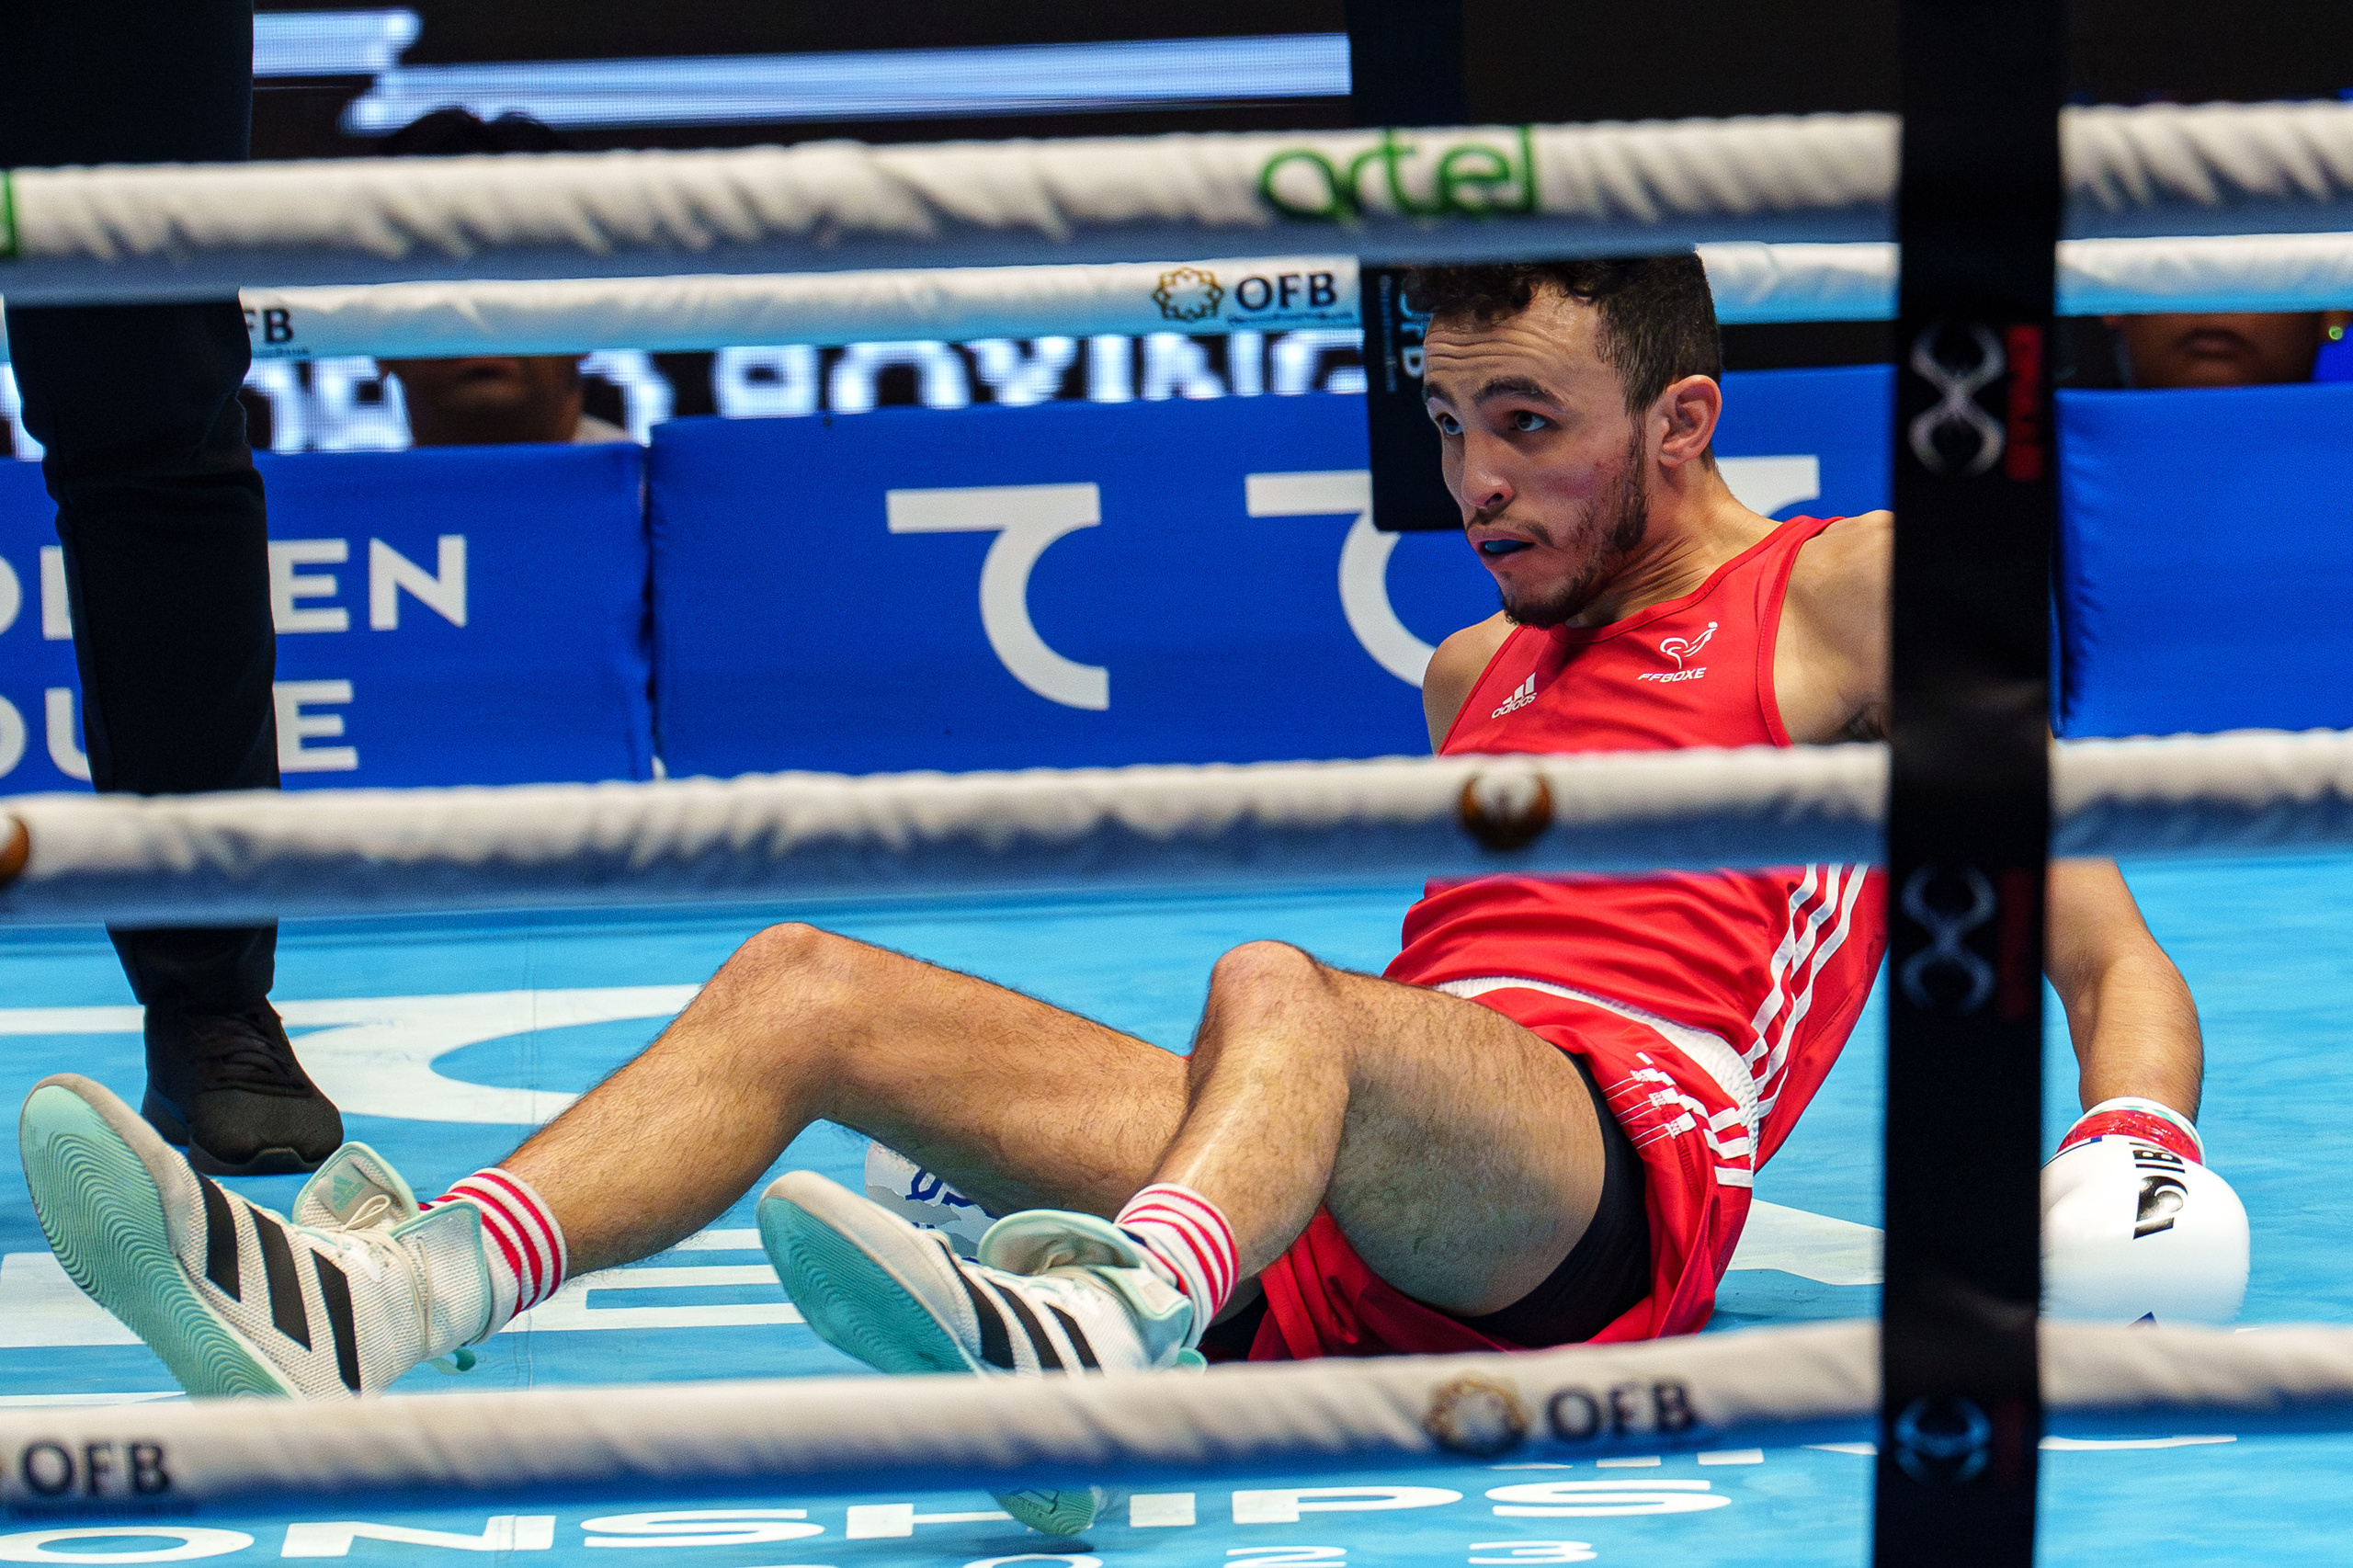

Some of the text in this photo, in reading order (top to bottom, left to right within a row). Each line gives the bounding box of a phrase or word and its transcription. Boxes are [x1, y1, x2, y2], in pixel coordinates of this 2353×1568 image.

[1257, 125, 1537, 221] artel
[1235, 270, 1337, 312] OFB
[1637, 667, 1707, 682] FFBOXE
[1491, 692, 1538, 719] adidas
[1546, 1381, 1694, 1443] OFB
[21, 1439, 171, 1496] OFB
